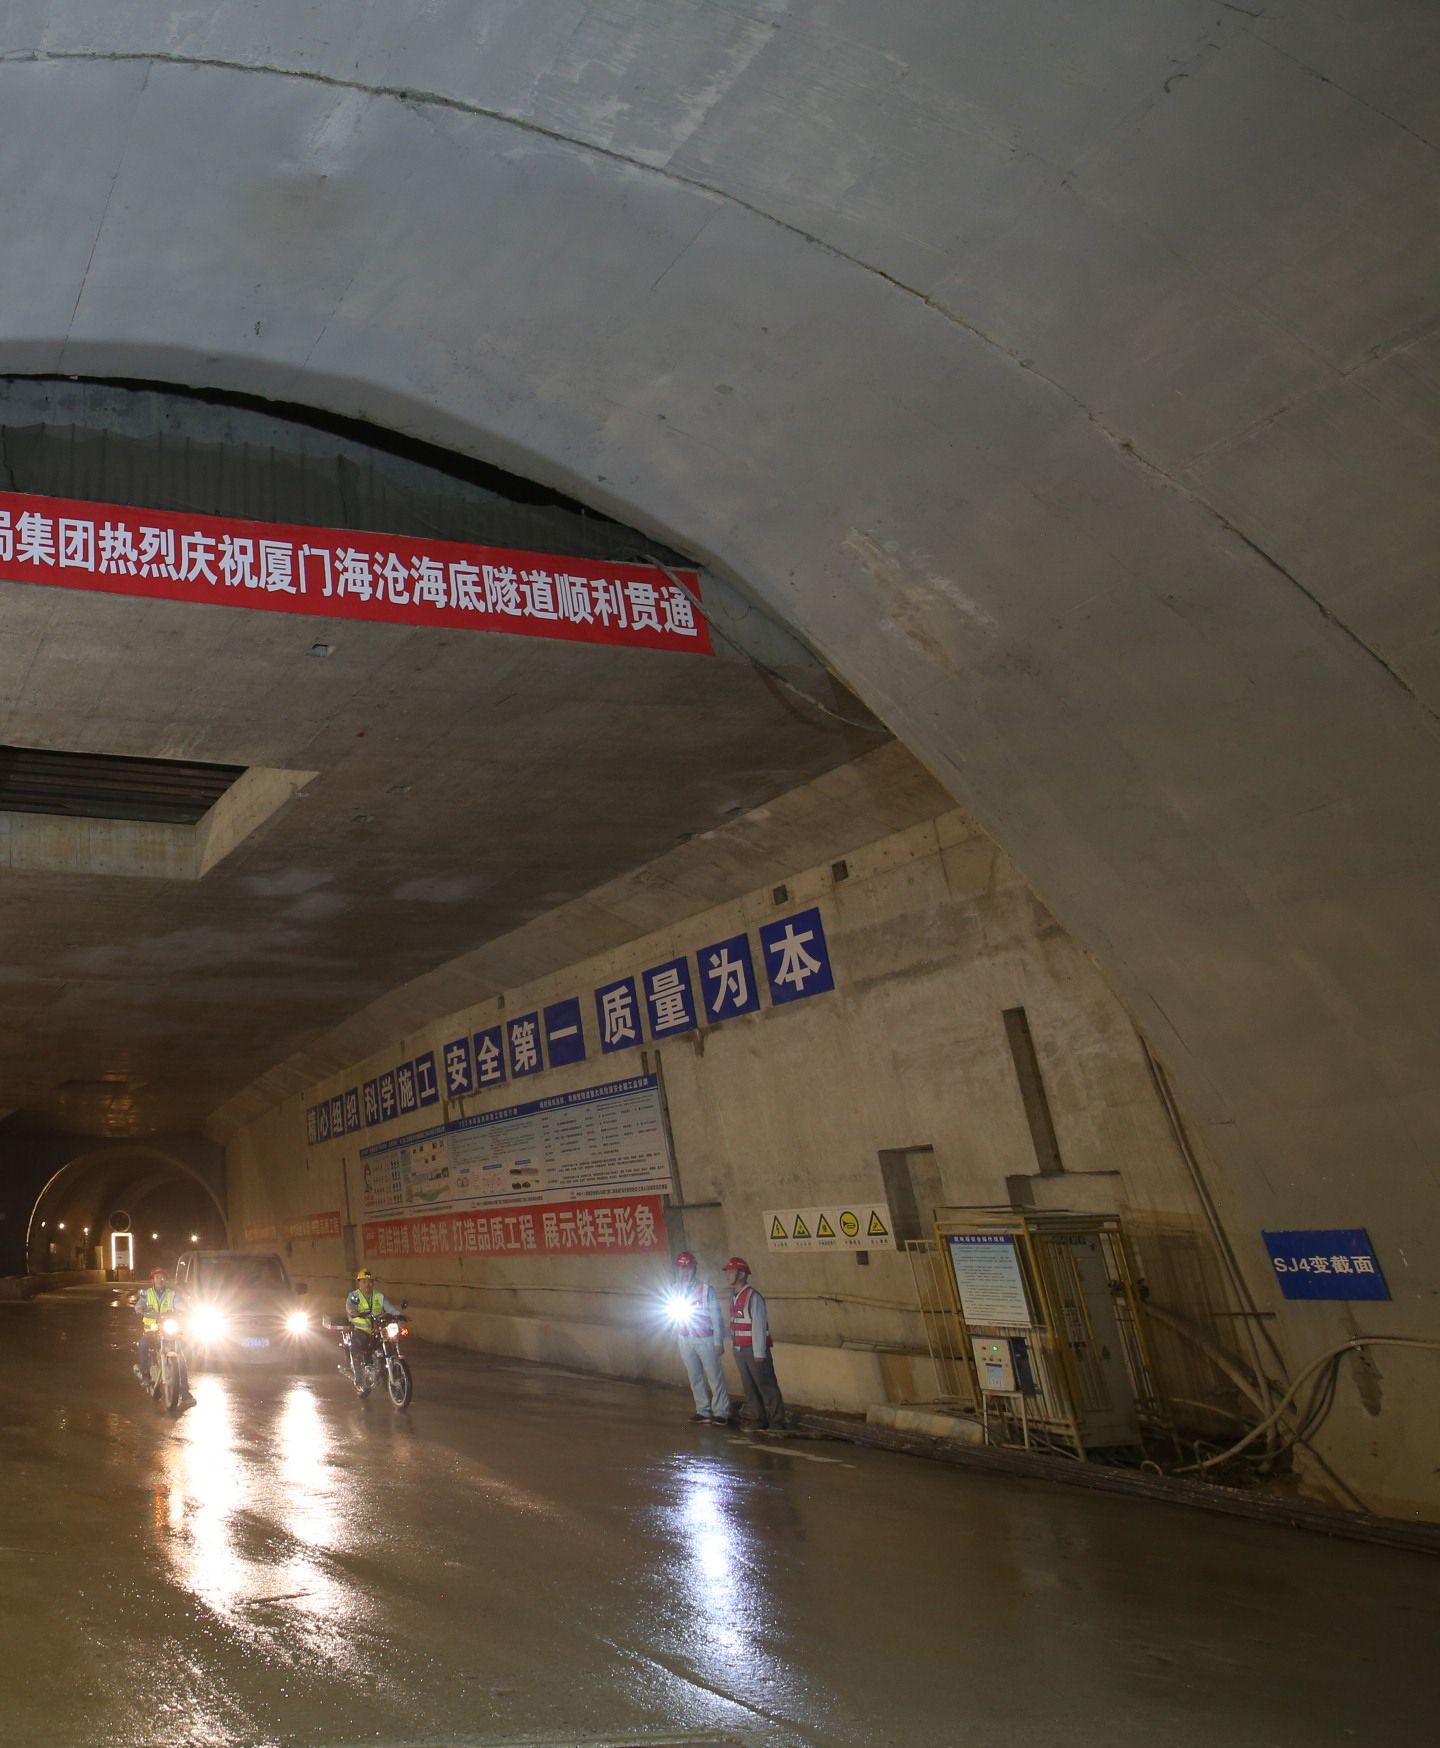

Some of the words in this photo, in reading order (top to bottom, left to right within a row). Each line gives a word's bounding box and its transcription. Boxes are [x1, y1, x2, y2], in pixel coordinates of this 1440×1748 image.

[308, 1094, 358, 1143] 精心组织
[365, 1061, 436, 1122] 科学施工
[447, 1020, 578, 1092] 安全第一
[603, 924, 821, 1044] 质量为本
[452, 1214, 536, 1253] 打造品质工程
[543, 1204, 658, 1250] 展示铁军形象
[1274, 1256, 1375, 1274] SJ4变截面
